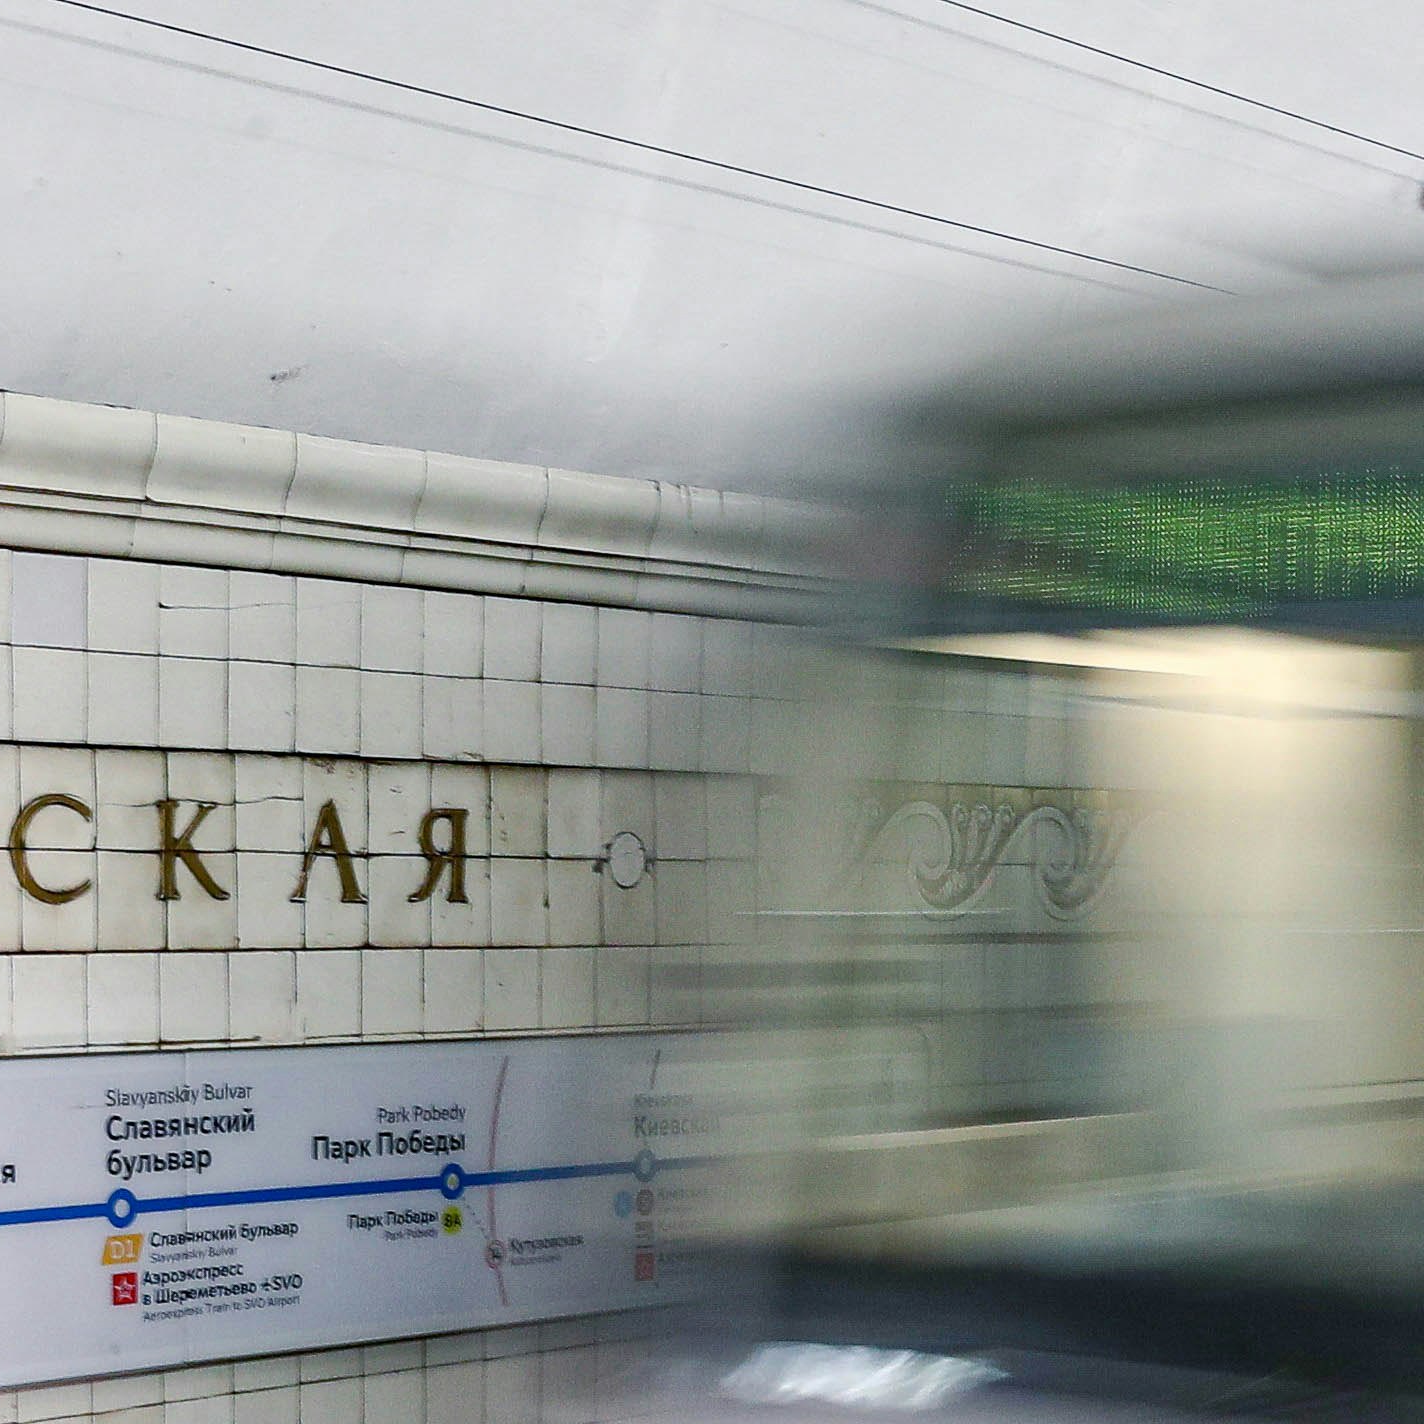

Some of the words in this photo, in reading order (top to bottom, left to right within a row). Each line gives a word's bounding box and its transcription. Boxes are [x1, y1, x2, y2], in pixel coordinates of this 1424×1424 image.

[106, 1085, 199, 1109] Slavyanskiy
[203, 1083, 253, 1101] Bulvar
[106, 1108, 256, 1141] Славянский
[377, 1107, 410, 1123] Park
[414, 1104, 466, 1122] Pobedy
[313, 1135, 371, 1164] Парк
[376, 1130, 466, 1156] Победы
[107, 1149, 212, 1180] бульвар
[346, 1213, 383, 1231] Парк
[384, 1209, 438, 1226] Победы
[150, 1225, 237, 1248] Славянский
[240, 1223, 299, 1243] бульвар
[109, 1239, 137, 1260] D1
[143, 1264, 244, 1286] Аэроэкспресс
[142, 1294, 152, 1306] в
[155, 1282, 257, 1305] Шереметьево
